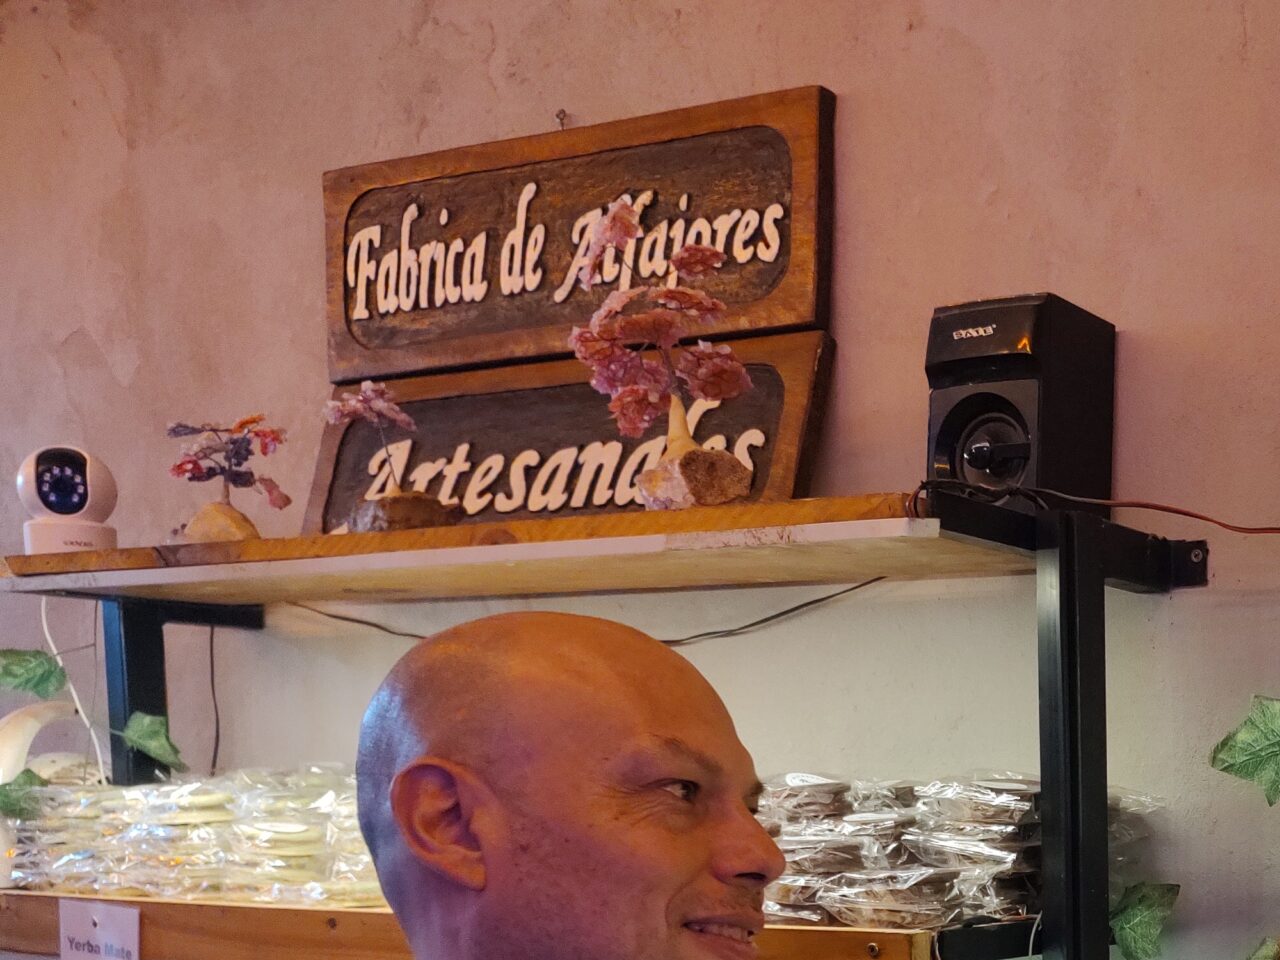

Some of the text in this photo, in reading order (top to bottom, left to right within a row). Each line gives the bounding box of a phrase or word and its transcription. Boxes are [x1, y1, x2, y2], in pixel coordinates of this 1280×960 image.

[346, 202, 489, 320] Fabrica
[500, 182, 546, 297] de
[364, 398, 766, 516] Artesanas
[68, 937, 100, 954] Yerba
